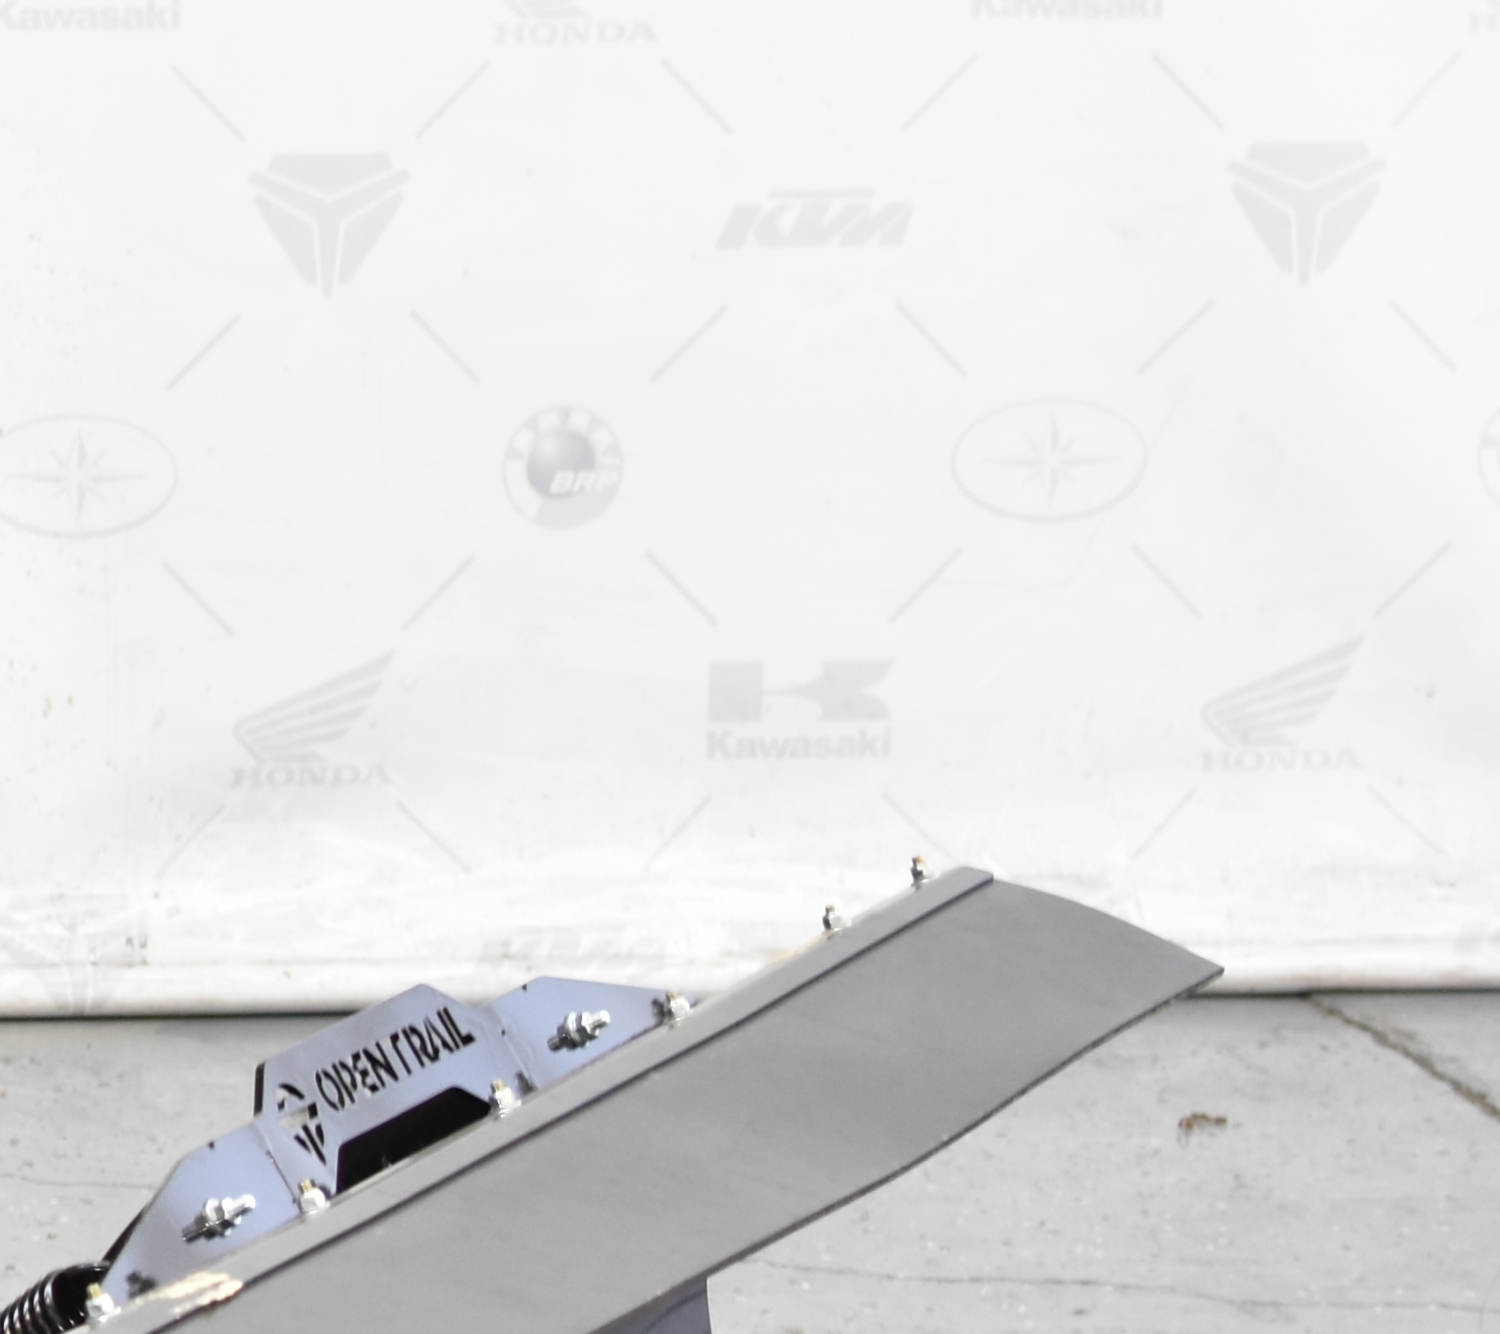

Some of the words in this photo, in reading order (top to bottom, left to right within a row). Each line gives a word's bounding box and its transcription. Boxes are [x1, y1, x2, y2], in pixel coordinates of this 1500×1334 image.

[493, 22, 661, 46] HONDA
[714, 189, 914, 251] KTM
[550, 470, 622, 493] BRP
[706, 730, 891, 760] Kawasaki
[1197, 747, 1365, 772] HONDA
[225, 764, 391, 790] HONDA
